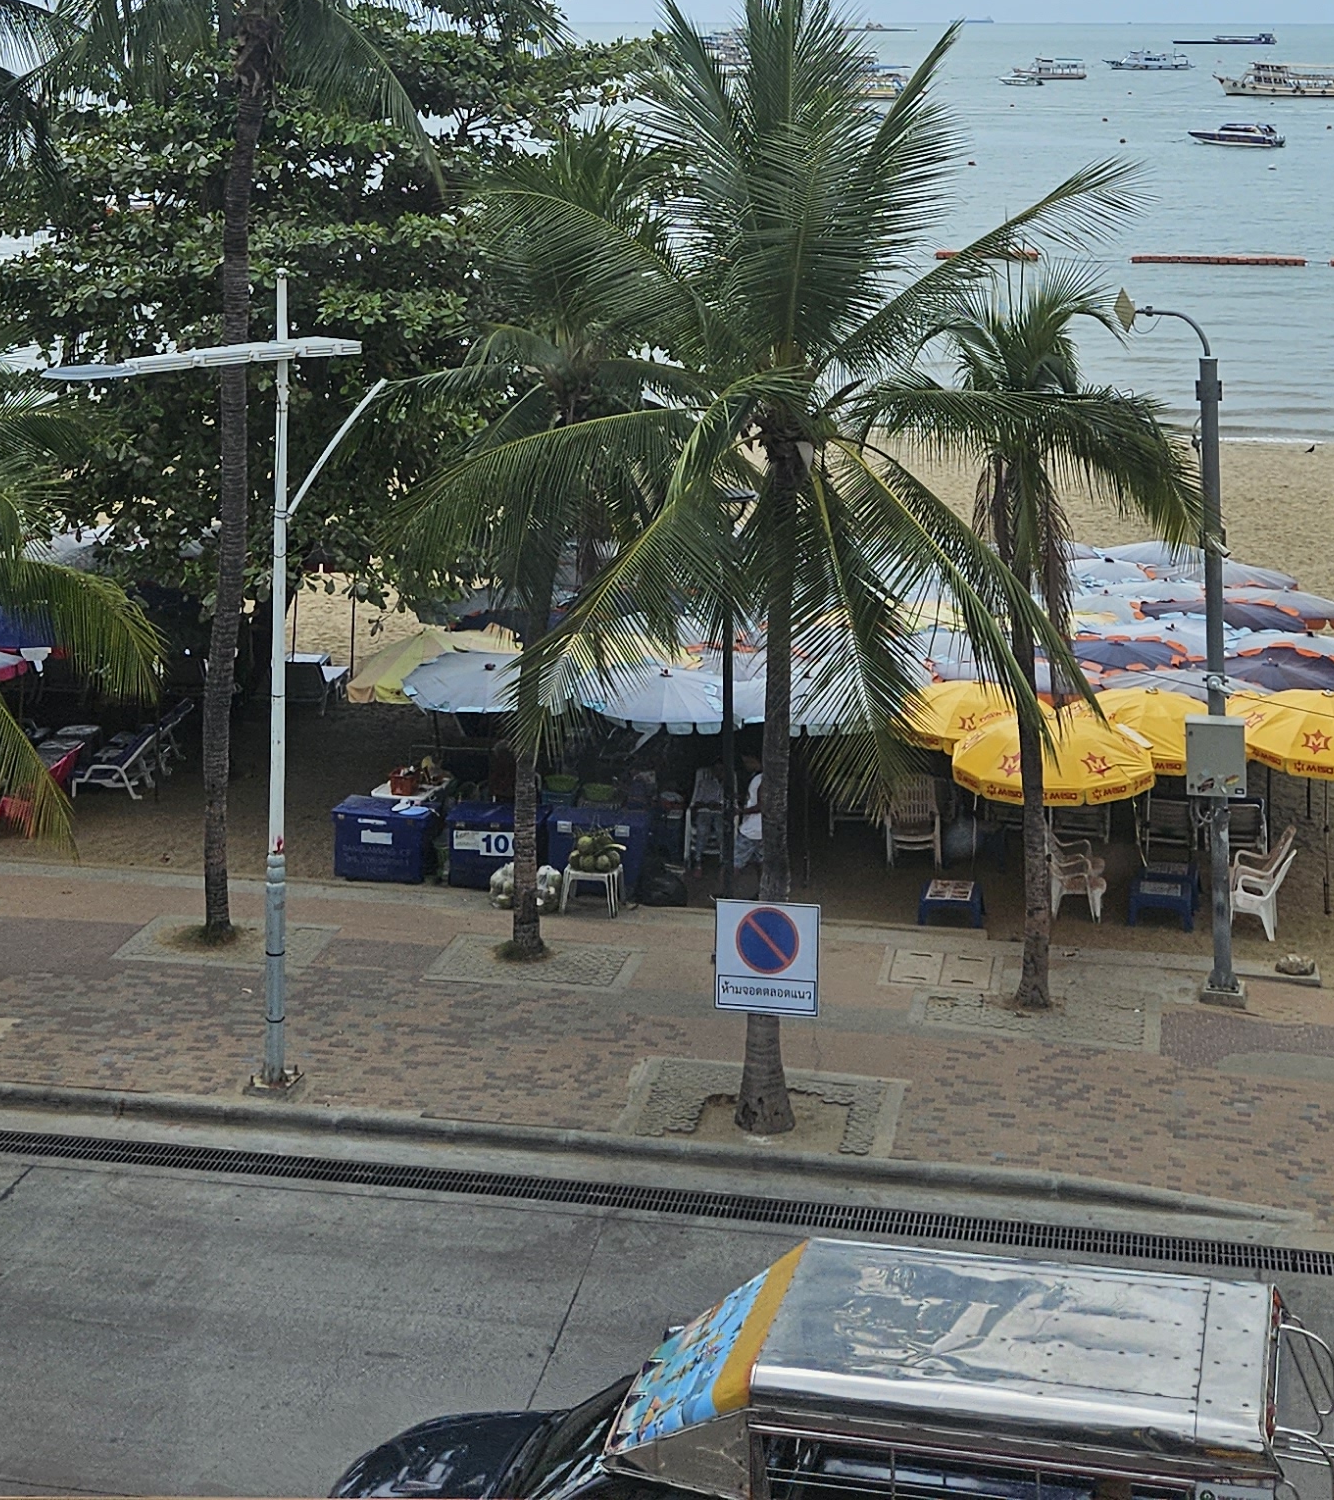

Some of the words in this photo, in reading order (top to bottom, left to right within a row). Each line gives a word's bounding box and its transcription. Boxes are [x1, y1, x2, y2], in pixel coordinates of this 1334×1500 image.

[482, 834, 515, 854] 10
[721, 980, 812, 1000] ห้ามจอดตลอดแนว
